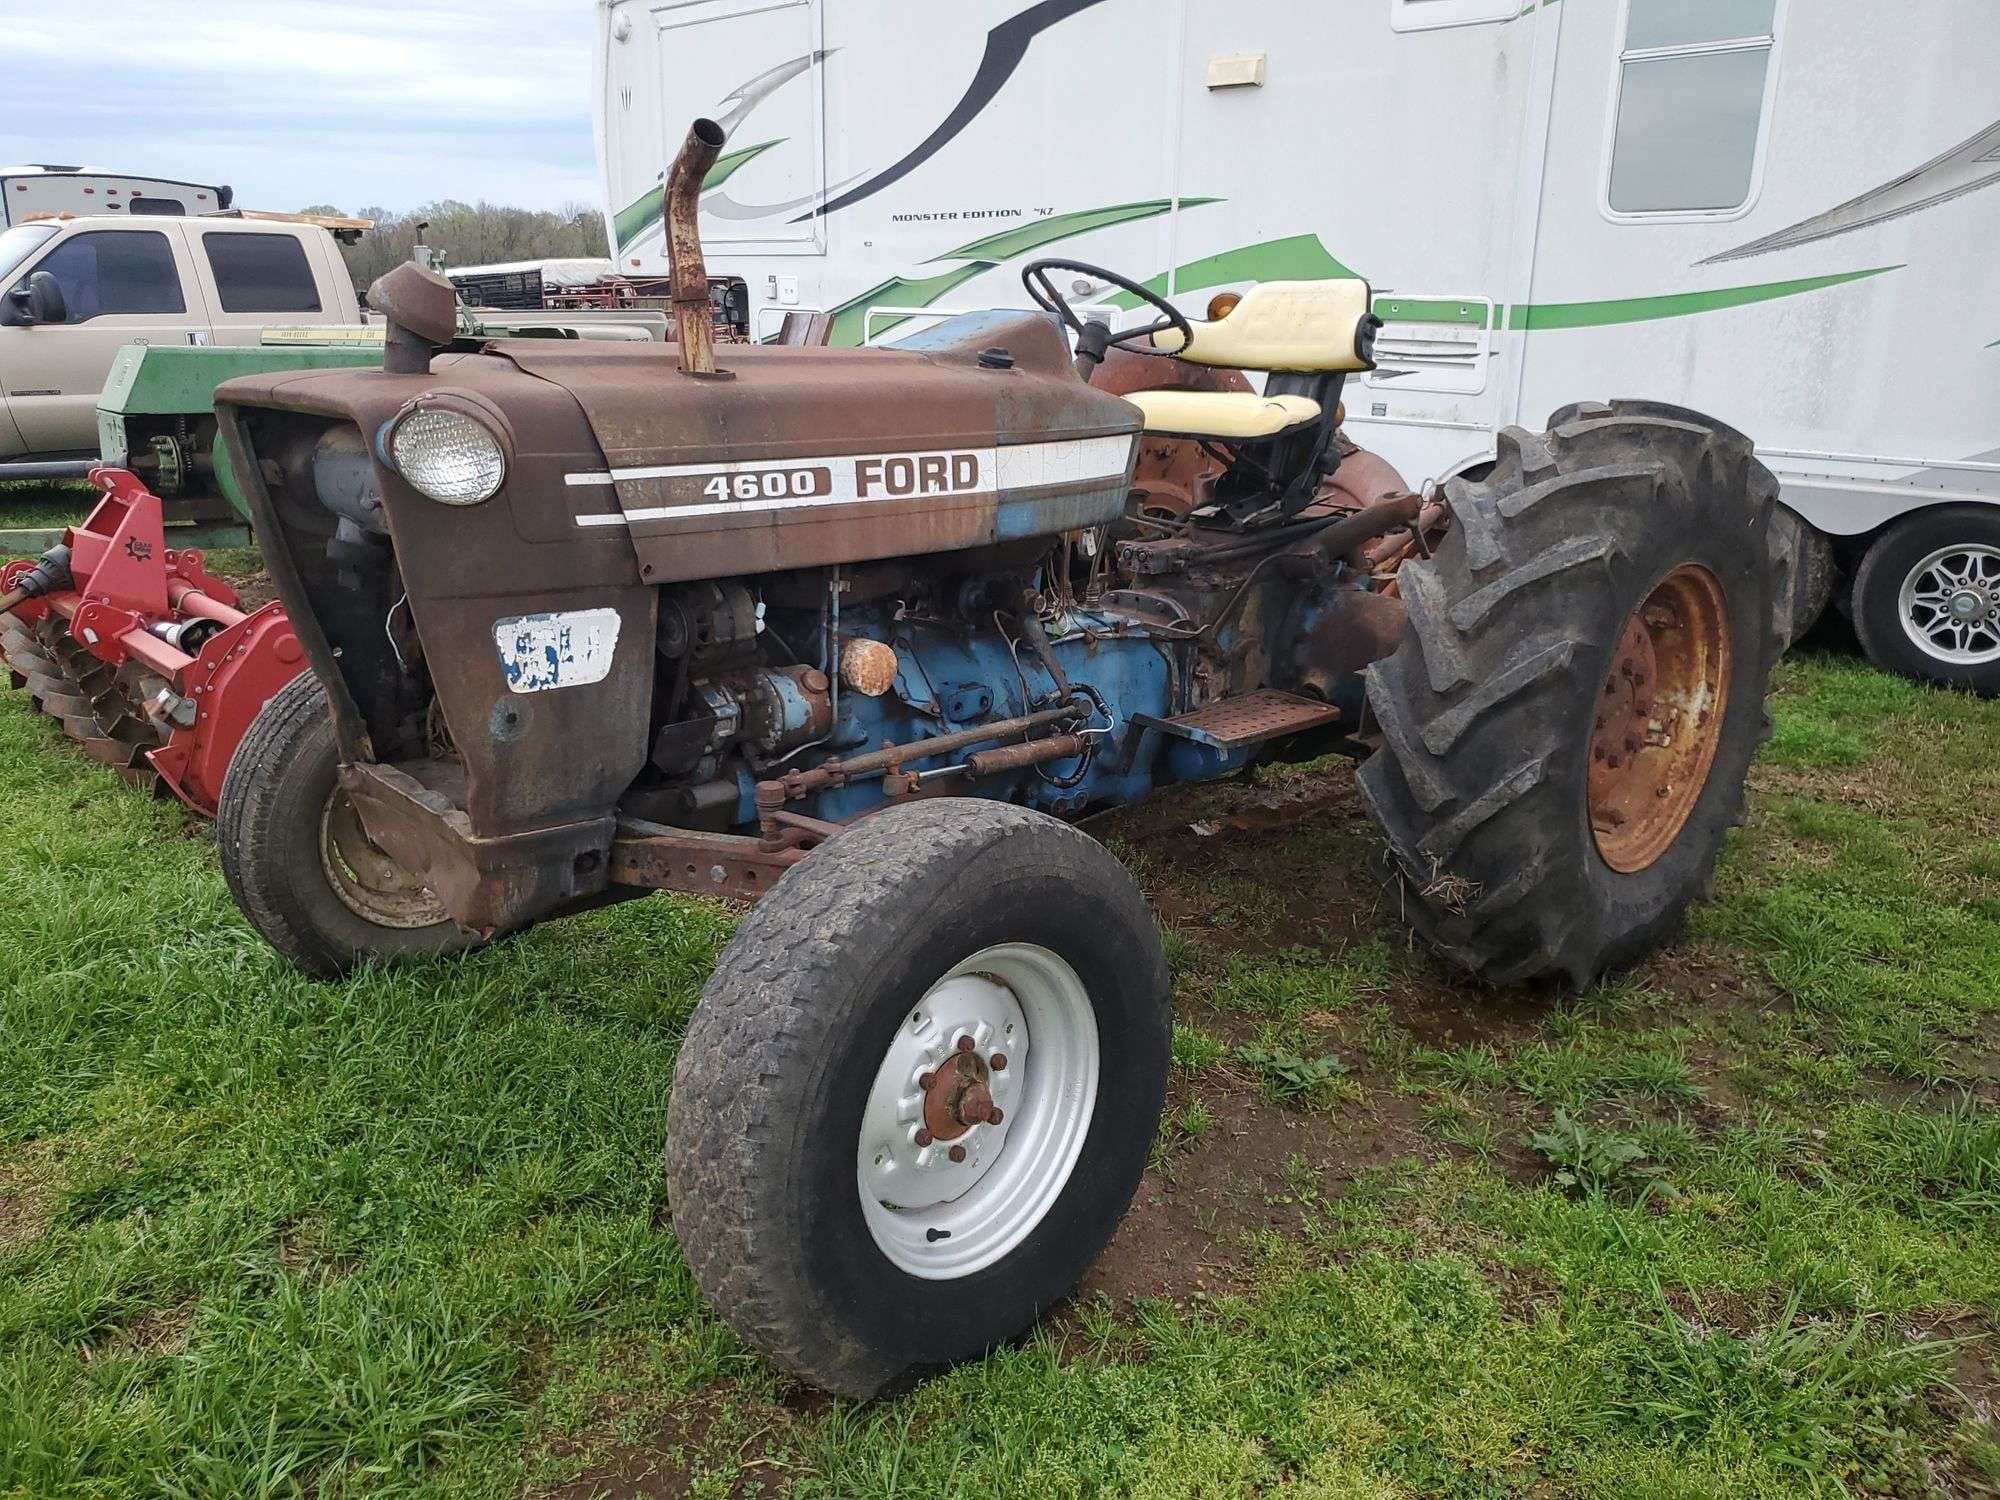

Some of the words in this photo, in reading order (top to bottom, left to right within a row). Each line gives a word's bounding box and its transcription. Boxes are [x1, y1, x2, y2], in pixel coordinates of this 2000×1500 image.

[892, 212, 958, 222] MONSTER
[963, 208, 1022, 219] EDITION
[703, 470, 817, 501] 4600
[855, 453, 980, 498] FORD
